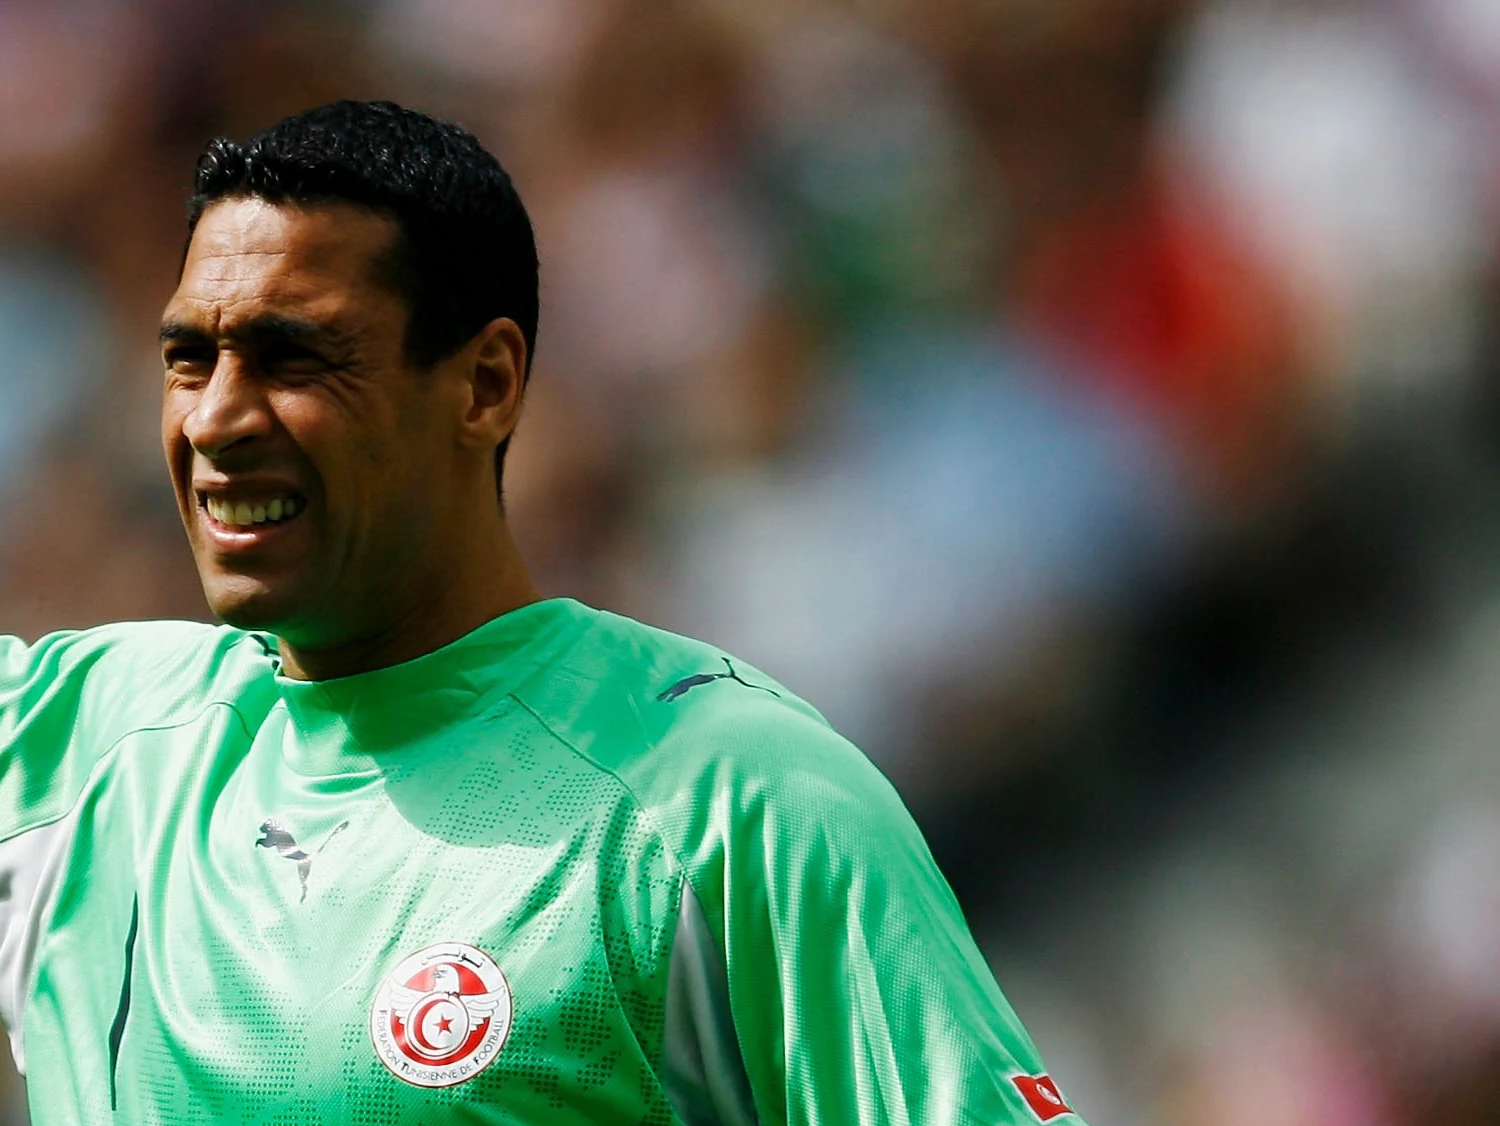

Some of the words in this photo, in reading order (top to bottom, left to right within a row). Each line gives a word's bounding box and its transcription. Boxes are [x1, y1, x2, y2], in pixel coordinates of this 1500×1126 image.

[401, 1061, 457, 1081] TUNISIENNE
[460, 1062, 474, 1075] DE
[473, 1020, 504, 1065] FOOTBALL
